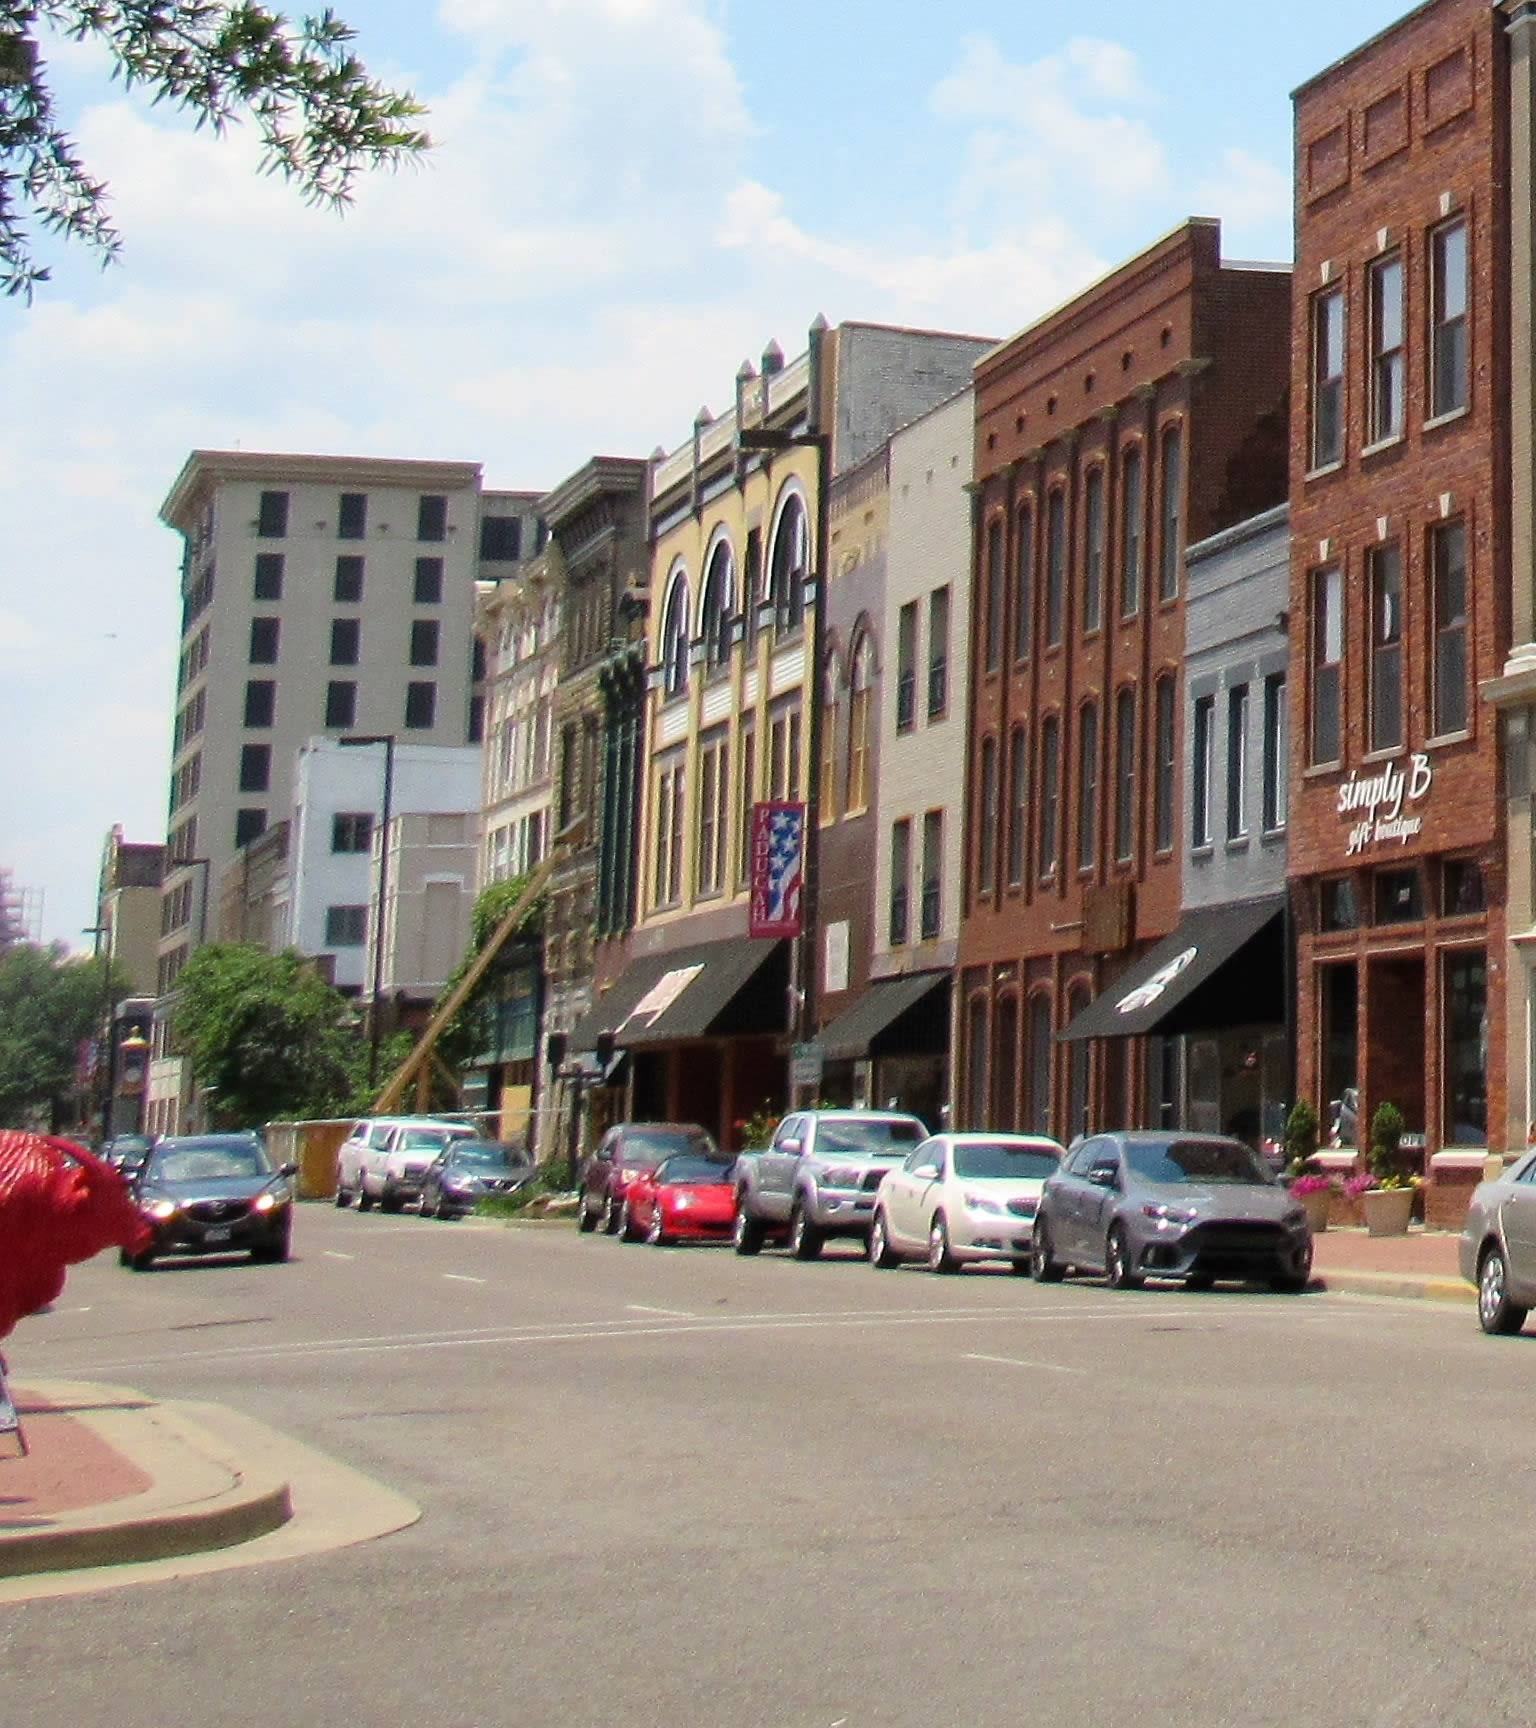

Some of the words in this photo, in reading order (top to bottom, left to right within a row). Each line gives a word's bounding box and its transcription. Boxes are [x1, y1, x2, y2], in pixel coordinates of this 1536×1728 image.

[1337, 761, 1406, 822] simply
[1408, 754, 1432, 800] B
[753, 808, 770, 921] PADUCAH
[1345, 822, 1373, 856] gift
[1374, 815, 1421, 845] boutique
